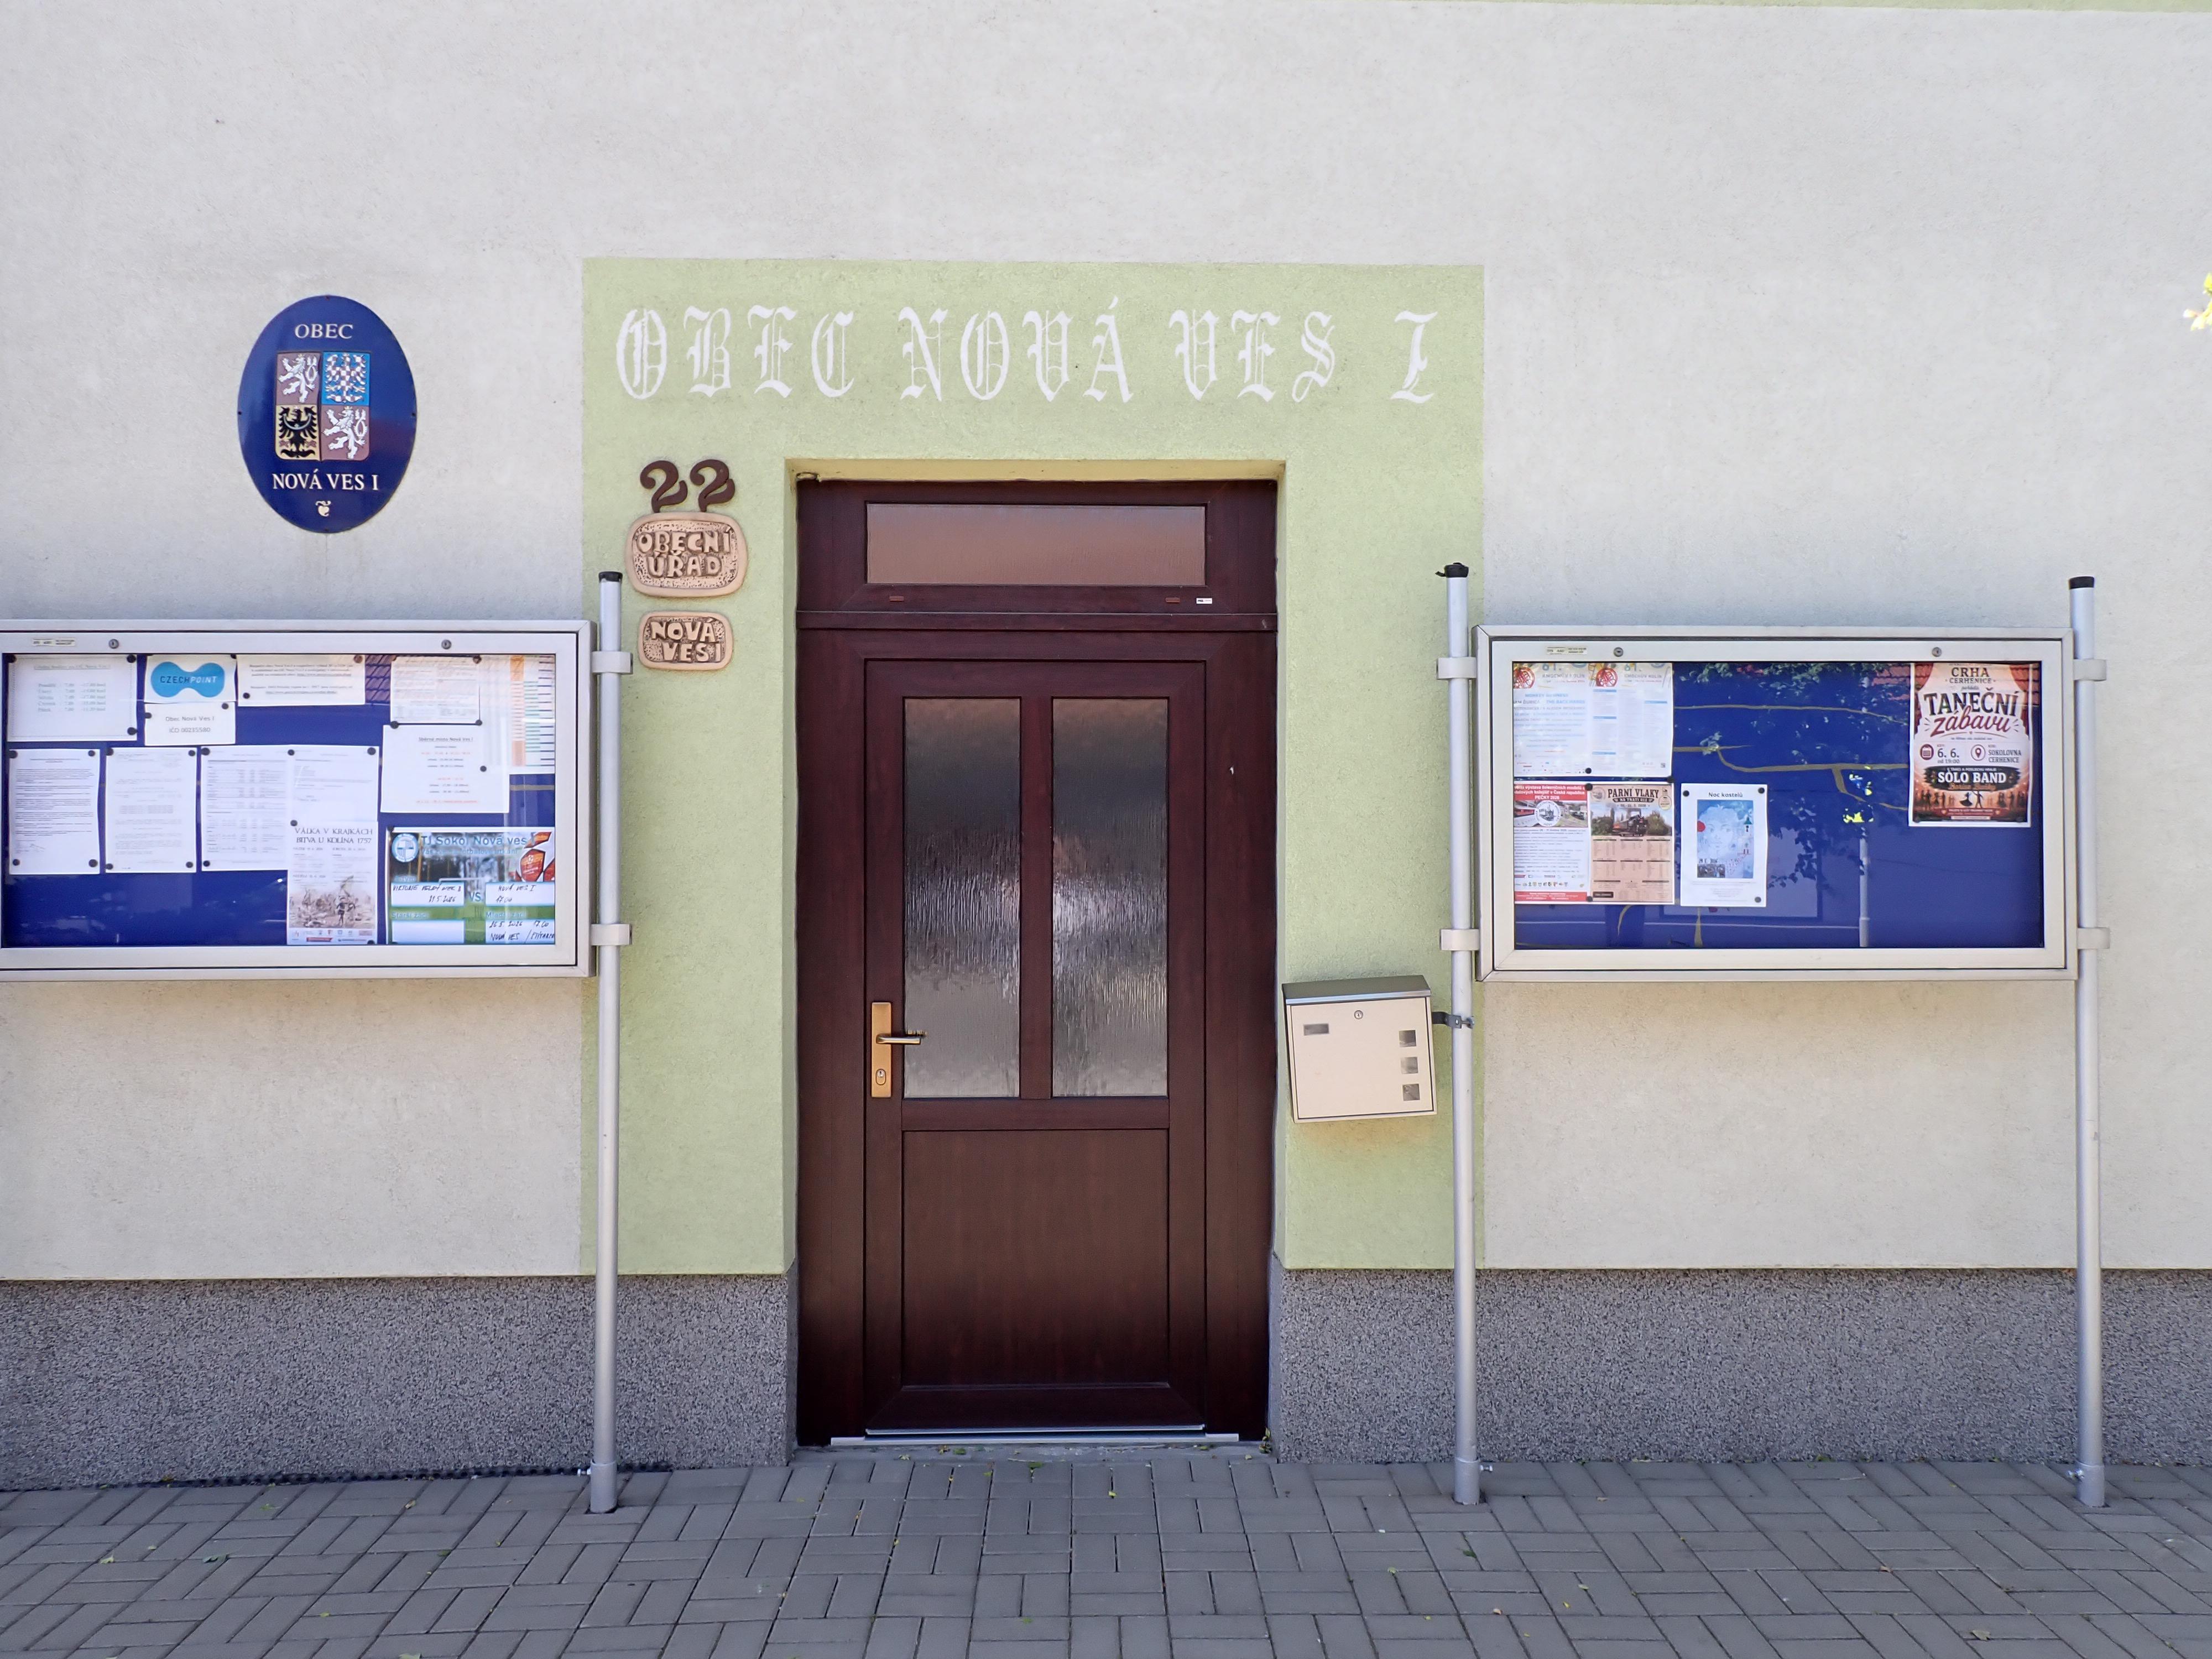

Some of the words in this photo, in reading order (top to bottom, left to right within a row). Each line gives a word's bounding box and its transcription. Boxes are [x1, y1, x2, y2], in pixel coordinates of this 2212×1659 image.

[295, 324, 354, 340] OBEC
[616, 305, 854, 399] OBEC
[899, 296, 1133, 402] NOVÁ
[1169, 309, 1335, 403] VES
[272, 469, 322, 489] NOVÁ
[327, 474, 367, 491] VES
[372, 474, 378, 491] I
[640, 459, 735, 513] 22
[637, 526, 733, 554] OBECNÍ
[647, 550, 722, 578] ÚŘAD
[650, 616, 718, 641] NOVÁ
[1951, 667, 1990, 677] CRHA
[1923, 687, 2020, 717] TANEČNÍ
[1931, 705, 2012, 737] zábavu
[1937, 748, 1947, 758] 6.
[1950, 748, 1960, 758] 6.
[1973, 772, 2006, 783] BAND
[1634, 789, 1659, 799] VLAKY
[421, 836, 431, 845] TJ
[473, 835, 504, 846] Nová
